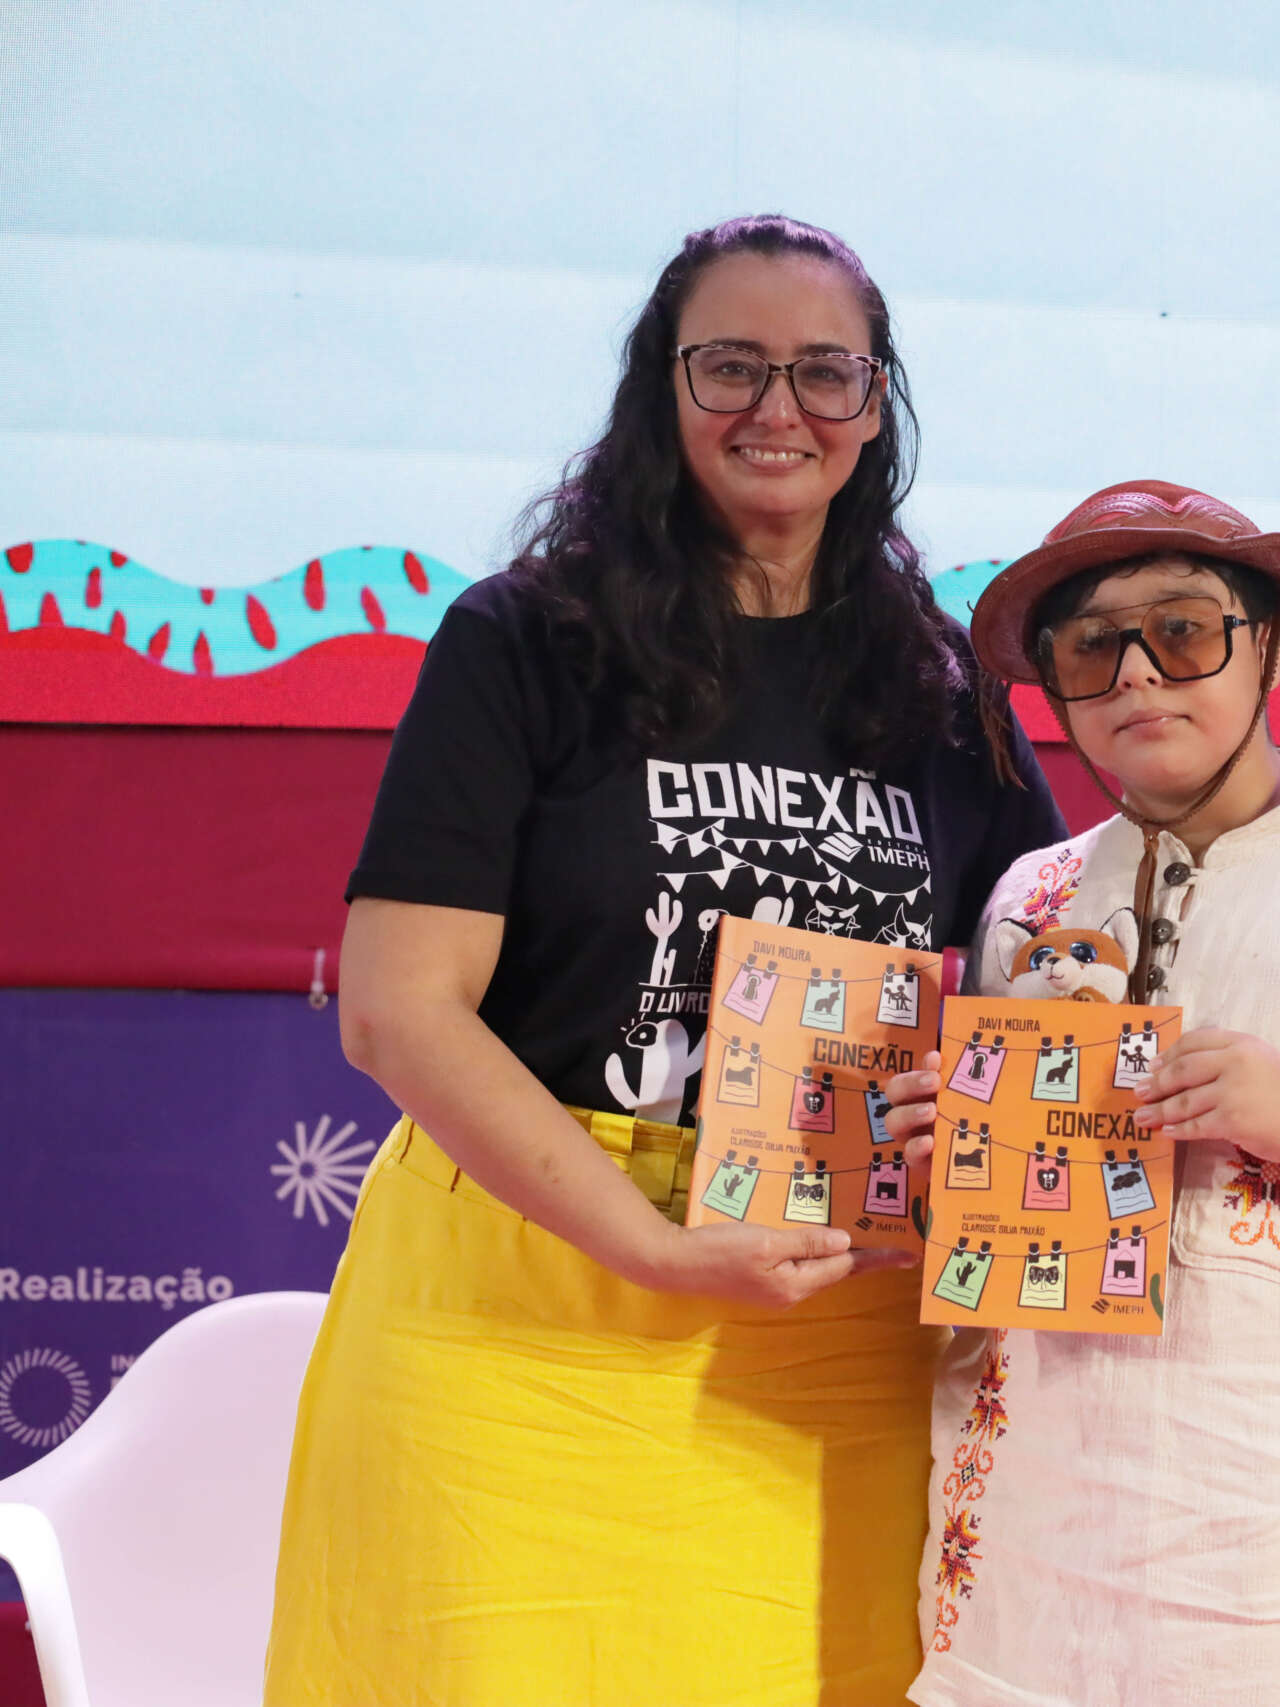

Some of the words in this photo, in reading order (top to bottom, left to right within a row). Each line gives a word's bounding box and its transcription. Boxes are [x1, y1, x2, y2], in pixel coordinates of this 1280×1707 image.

[647, 759, 923, 845] CONEXÃO
[868, 846, 930, 872] IMEPH
[753, 940, 776, 956] DAVI
[778, 945, 811, 963] MOURA
[638, 991, 656, 1013] O
[656, 991, 711, 1014] LIVRO
[977, 1016, 1002, 1030] DAVI
[1005, 1018, 1041, 1033] MOURA
[812, 1037, 914, 1074] CONEXÃO
[1046, 1109, 1152, 1142] CONEXÃO
[876, 1223, 906, 1233] IMEPH
[961, 1222, 997, 1233] CLARISSE
[0, 1267, 234, 1311] Realização
[1113, 1304, 1145, 1315] IMEPH
